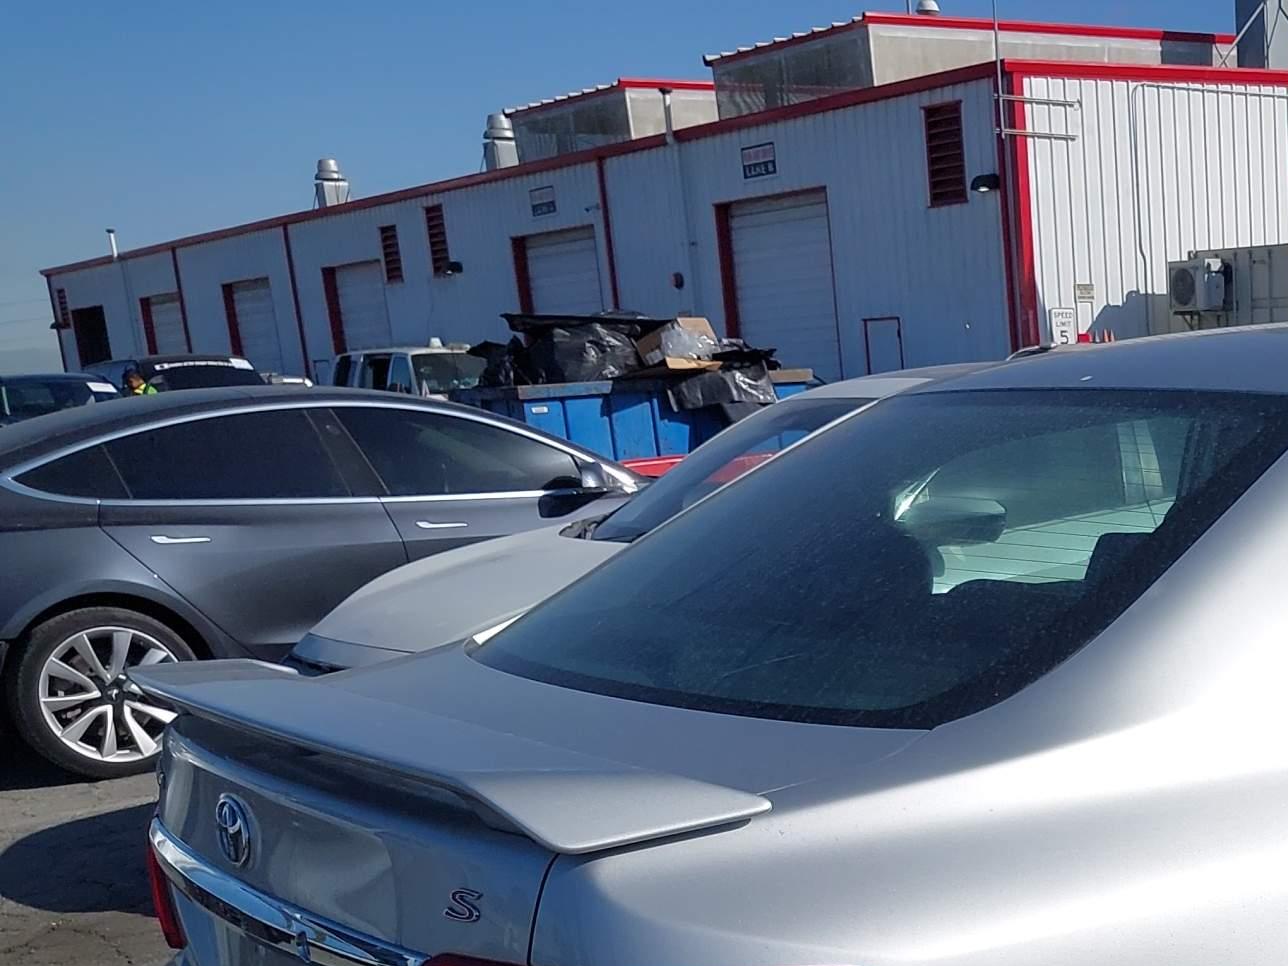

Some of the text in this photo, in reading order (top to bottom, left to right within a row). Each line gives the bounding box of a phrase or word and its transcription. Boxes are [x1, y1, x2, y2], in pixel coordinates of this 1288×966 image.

[1053, 311, 1073, 319] SPEED
[1055, 320, 1072, 328] LIMIT
[1059, 330, 1069, 345] 5
[443, 888, 484, 923] S
